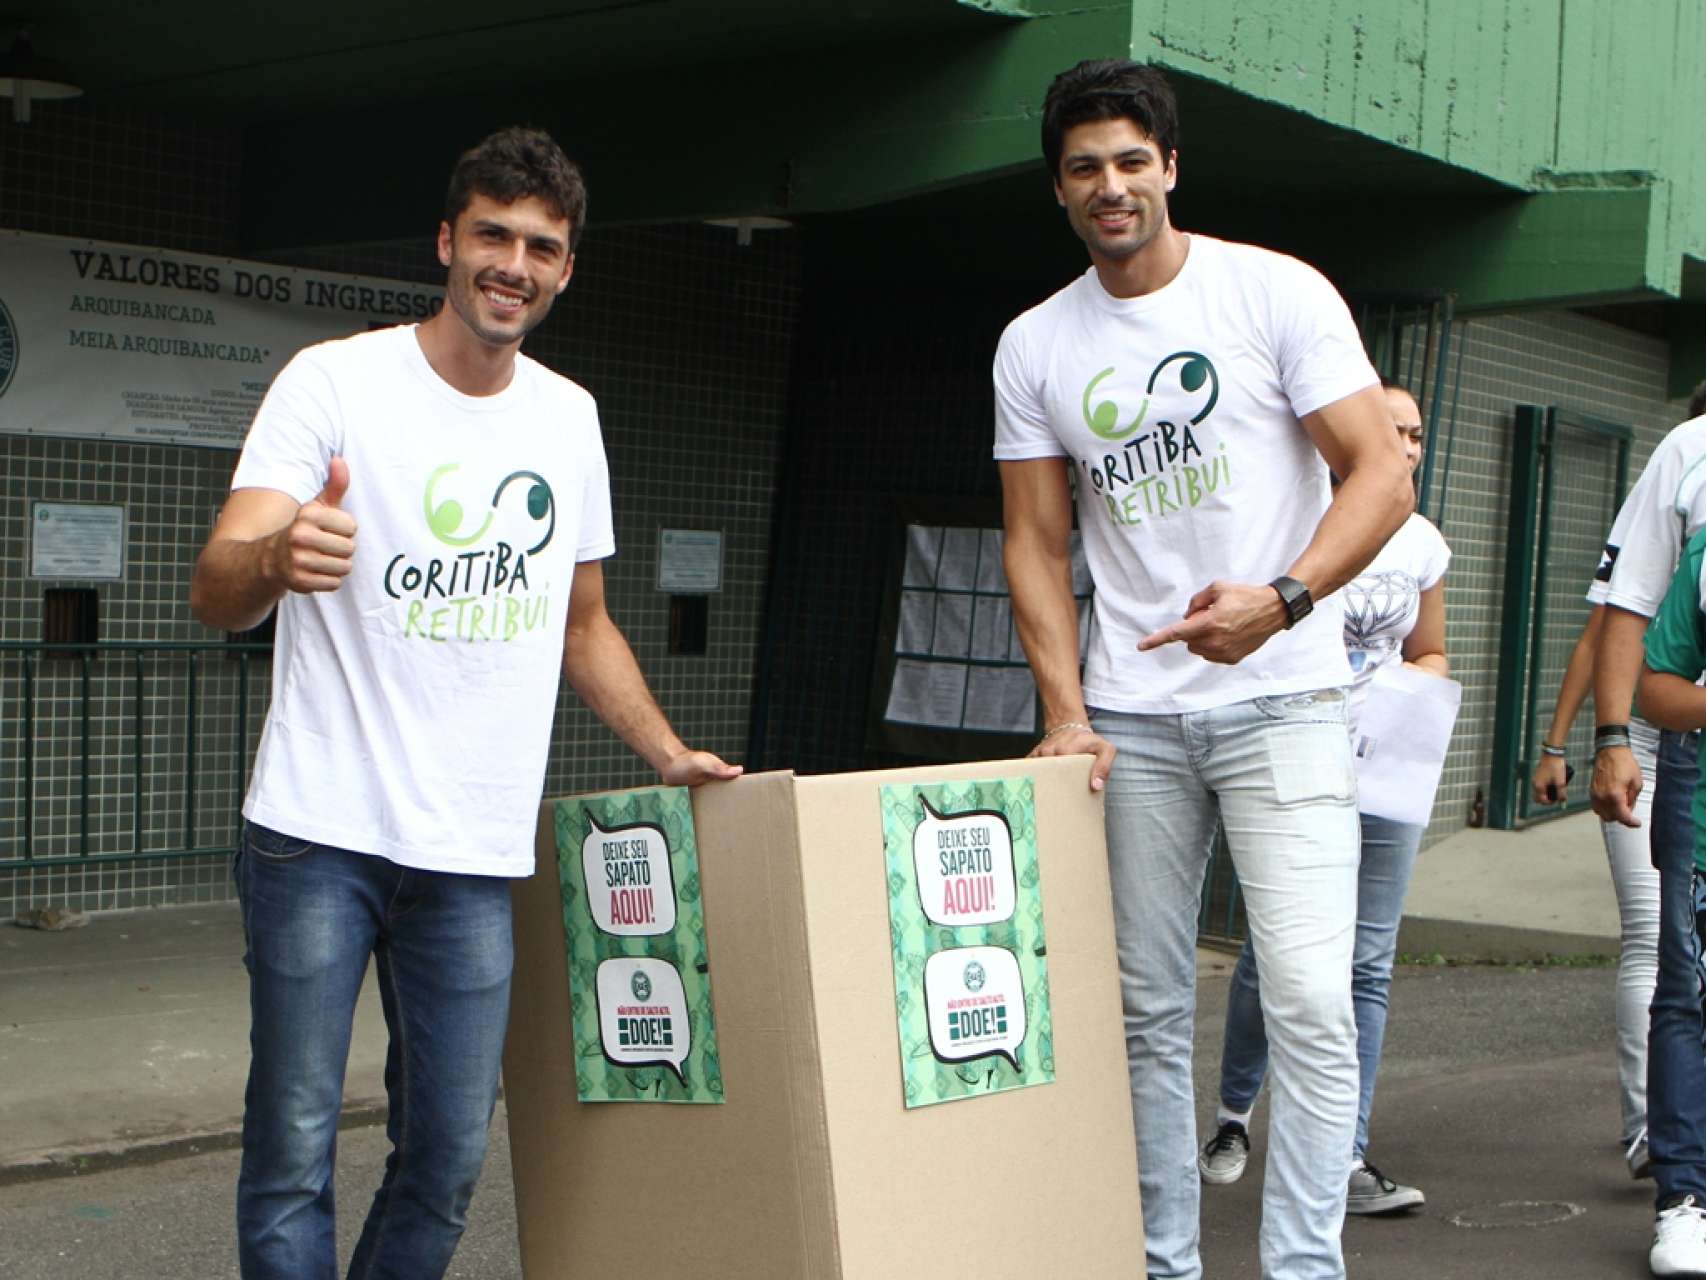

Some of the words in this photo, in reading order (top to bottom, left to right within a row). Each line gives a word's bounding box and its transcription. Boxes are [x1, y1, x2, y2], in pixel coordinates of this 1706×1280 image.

[71, 251, 220, 293] VALORES
[233, 270, 292, 302] DOS
[70, 295, 216, 326] ARQUIBANCADA
[69, 329, 118, 351] MEIA
[602, 840, 629, 861] DEIXE
[630, 839, 649, 860] SEU
[937, 829, 968, 849] DEIXE
[970, 827, 991, 847] SEU
[605, 860, 651, 888] SAPATO
[939, 847, 993, 876] SAPATO
[610, 887, 656, 926] AQUI!
[943, 875, 996, 916] AQUI!
[629, 1017, 663, 1046] DOE!
[960, 1006, 997, 1039] DOE!
